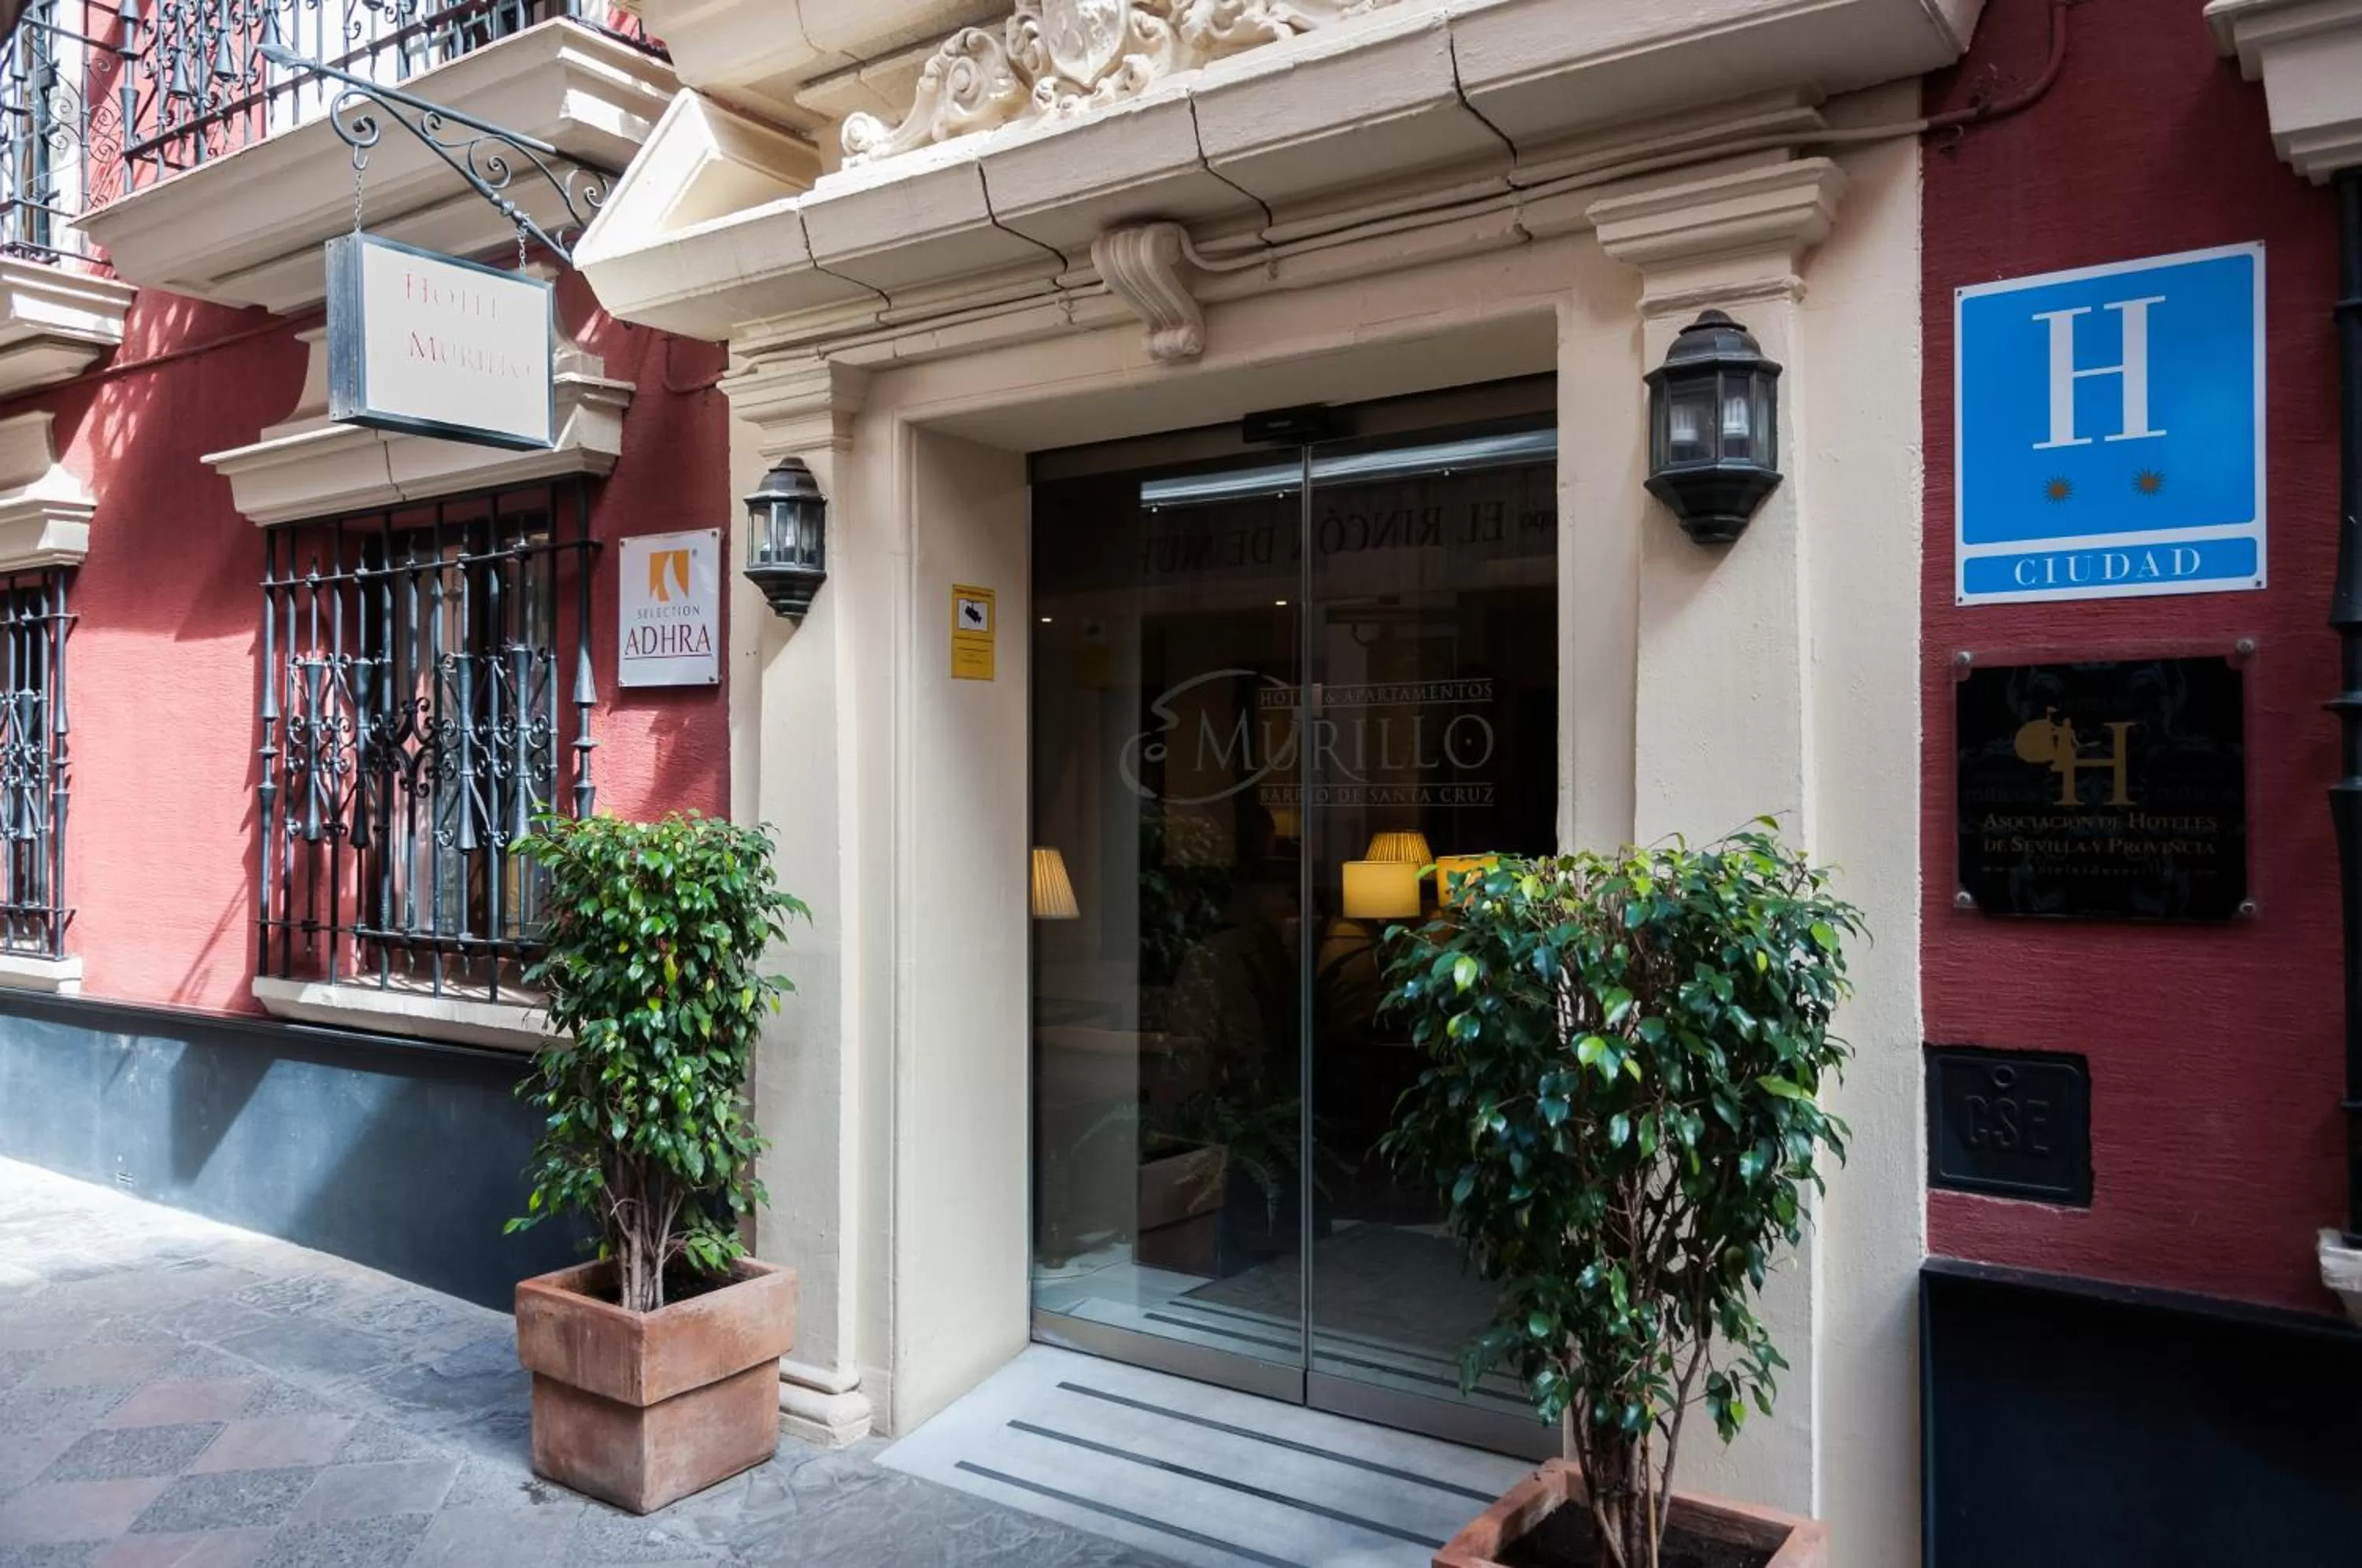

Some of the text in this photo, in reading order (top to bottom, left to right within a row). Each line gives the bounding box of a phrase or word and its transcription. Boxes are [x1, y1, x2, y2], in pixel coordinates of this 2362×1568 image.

[2032, 295, 2167, 449] H
[2014, 548, 2201, 587] CIUDAD
[637, 604, 701, 619] SELECTION
[624, 623, 712, 656] ADHRA
[1194, 708, 1494, 782] MURILLO
[1337, 787, 1361, 804] DE
[1370, 787, 1431, 804] SANTA
[1438, 786, 1495, 804] CRUZ
[2128, 811, 2219, 831] HOTELES
